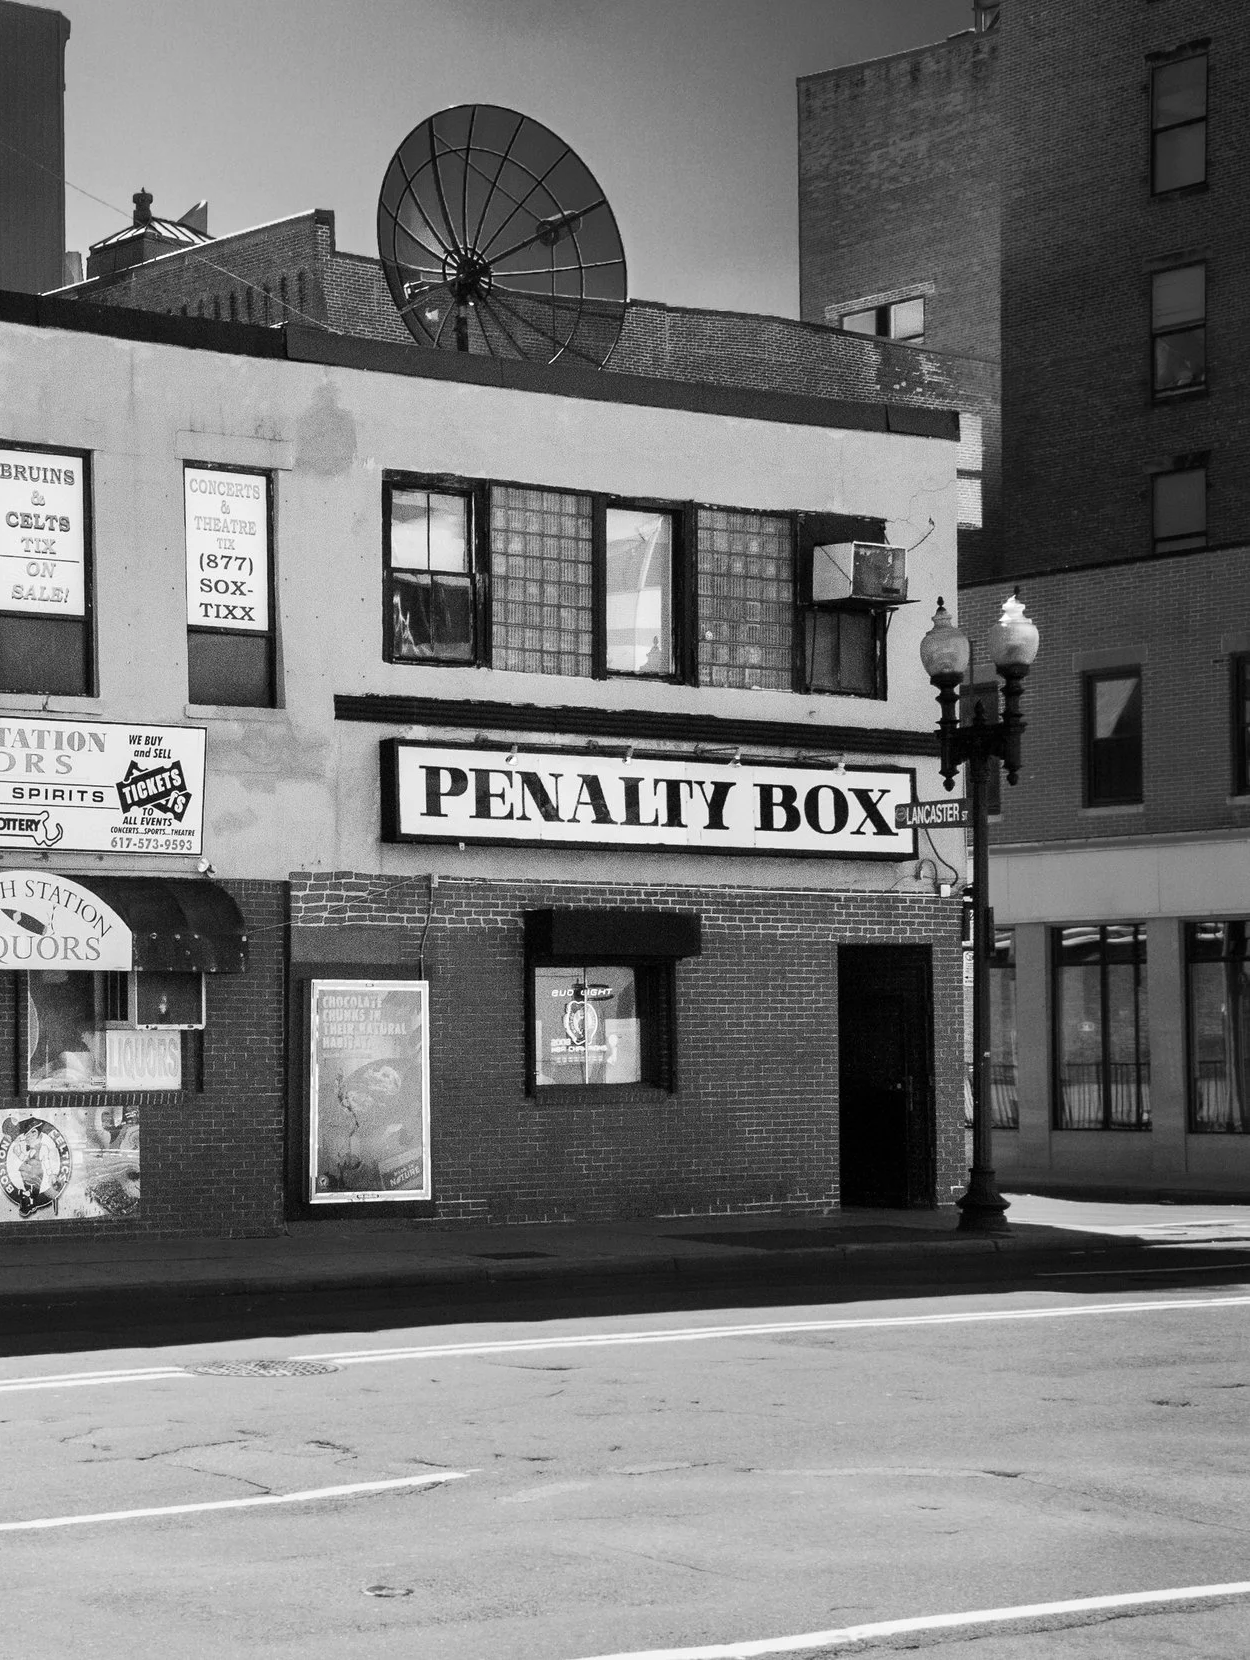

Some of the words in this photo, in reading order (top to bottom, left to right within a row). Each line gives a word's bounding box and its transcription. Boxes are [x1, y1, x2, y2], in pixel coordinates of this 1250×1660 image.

[0, 463, 75, 486] BRUINS
[189, 478, 261, 500] CONCERTS
[31, 490, 46, 507] &
[220, 500, 231, 514] &
[5, 511, 71, 532] CELTS
[194, 516, 257, 536] THEATRE
[20, 536, 57, 555] TIX
[216, 537, 236, 550] TIX
[26, 561, 56, 578] ON
[199, 553, 255, 576] (877)
[11, 584, 70, 604] SALE!
[199, 578, 254, 597] SOX-
[199, 602, 256, 622] TIXX
[129, 735, 142, 746] WE
[144, 735, 163, 747] BUY
[133, 747, 151, 759] and
[153, 748, 172, 759] SELL
[12, 787, 104, 803] SPIRITS
[121, 768, 182, 805] TICKETS
[419, 763, 737, 831] PENALTY
[751, 782, 899, 837] BOX
[142, 807, 154, 816] TO
[906, 803, 960, 825] LANCASTER
[122, 816, 137, 826] ALL
[140, 816, 172, 827] EVENTS
[110, 837, 193, 851] 617-573-9593
[24, 880, 113, 938] STATION
[552, 989, 575, 997] BUD
[322, 996, 382, 1009] CHOCOLATE
[323, 1009, 365, 1021] CHUNKS
[370, 1010, 382, 1021] IN
[323, 1022, 354, 1035] THEIR
[359, 1022, 407, 1035] NATURAL
[107, 1037, 179, 1078] LIQUORS
